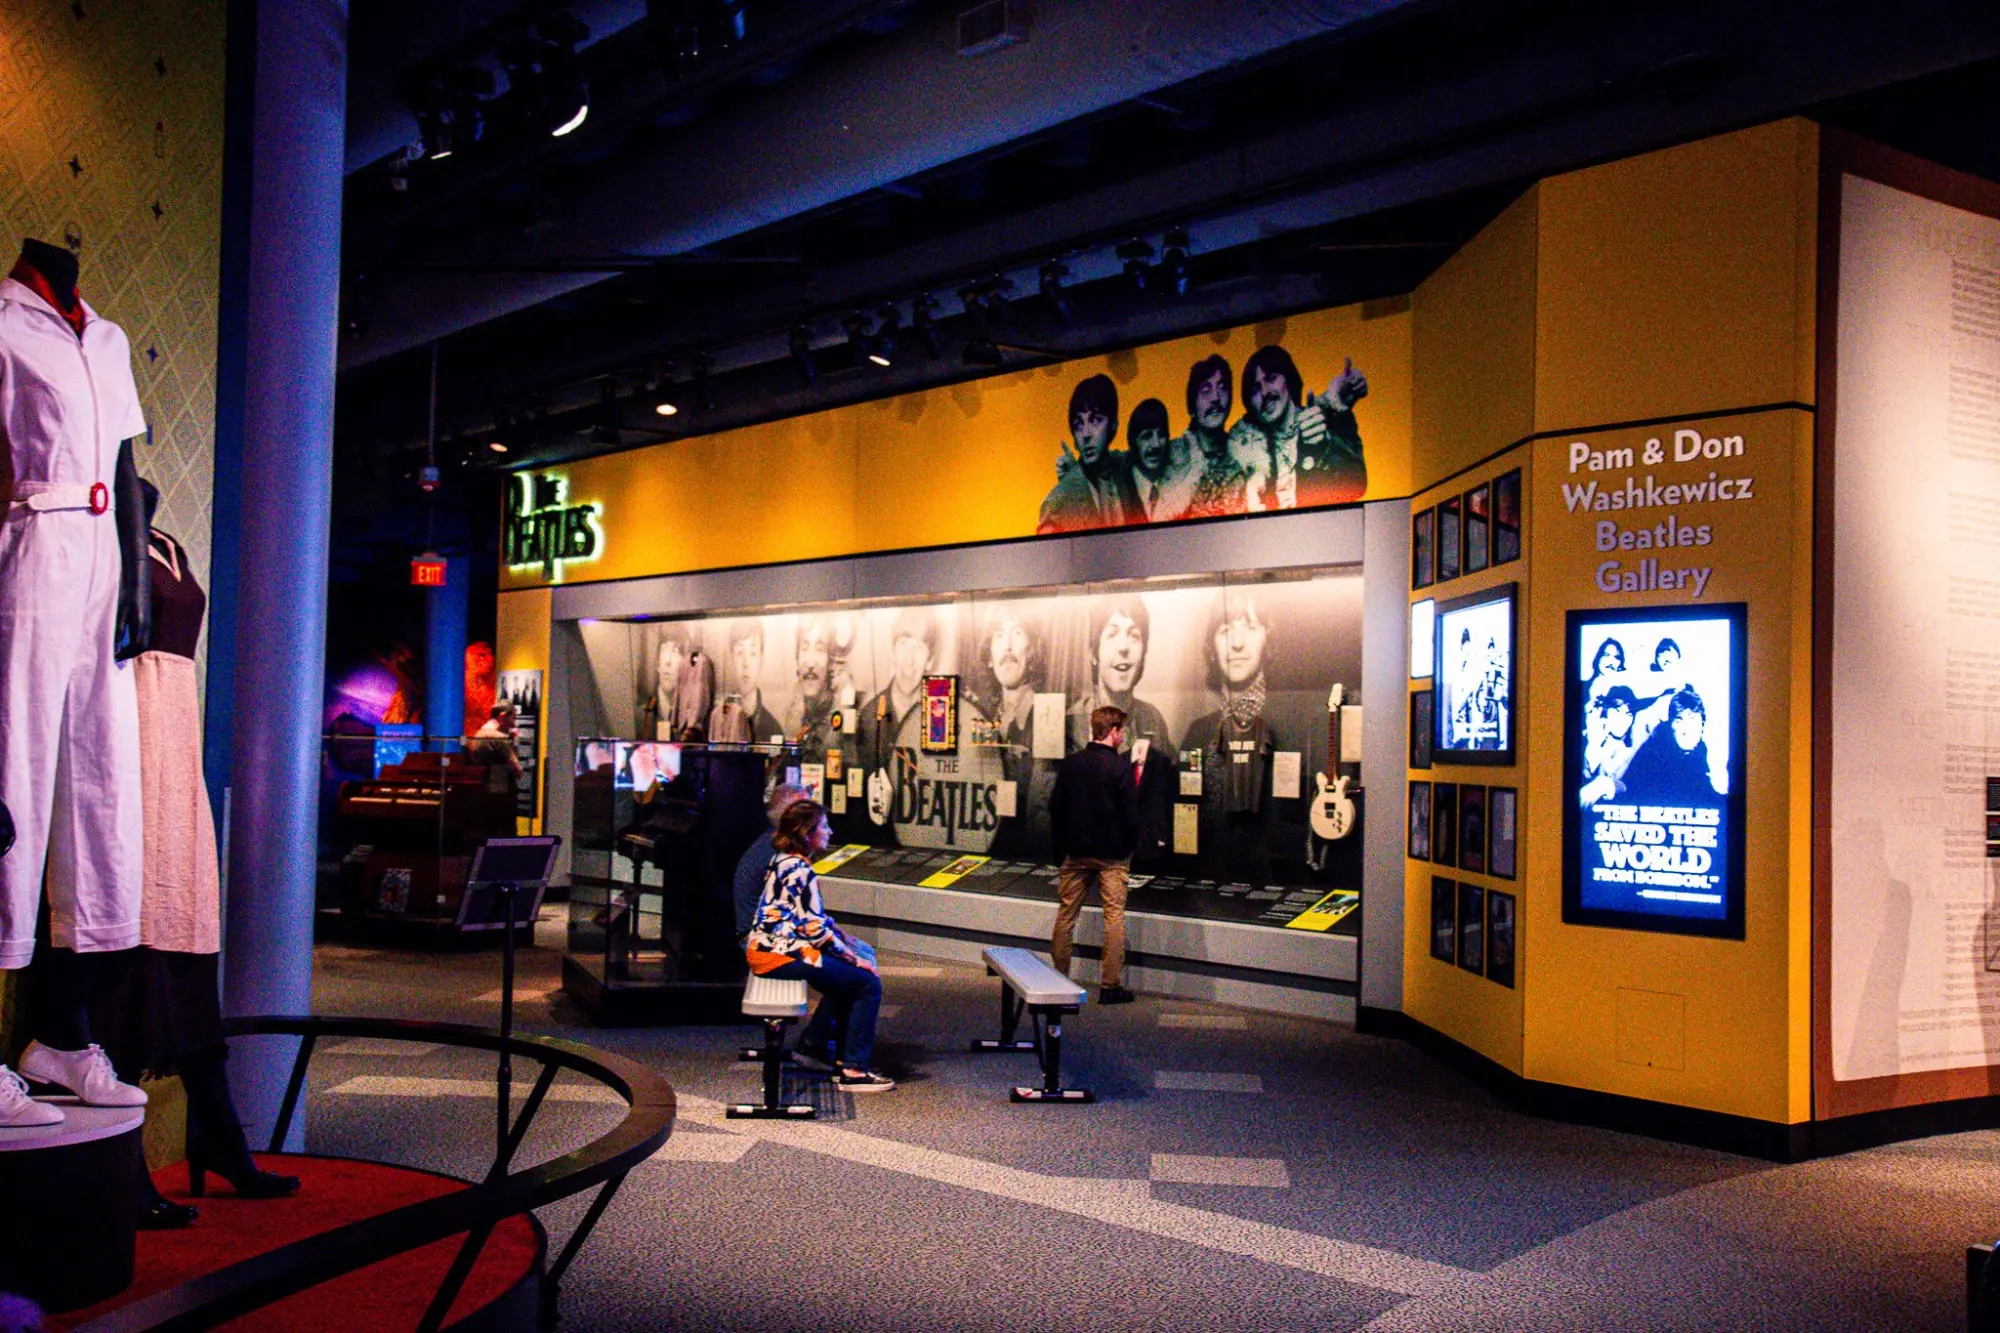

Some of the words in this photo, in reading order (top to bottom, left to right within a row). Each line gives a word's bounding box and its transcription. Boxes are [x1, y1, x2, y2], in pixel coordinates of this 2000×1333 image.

[1569, 442, 1633, 473] Pam
[1642, 438, 1664, 465] &
[1674, 429, 1744, 462] Don
[1561, 472, 1753, 515] Washkewicz
[1596, 515, 1713, 552] Beatles
[419, 566, 441, 582] EXIT
[1596, 558, 1712, 597] Gallery
[934, 759, 959, 774] THE
[896, 746, 998, 846] BEATLES
[1594, 822, 1666, 844] SAVED
[1668, 825, 1718, 847] THE
[1599, 842, 1712, 874] WORLD
